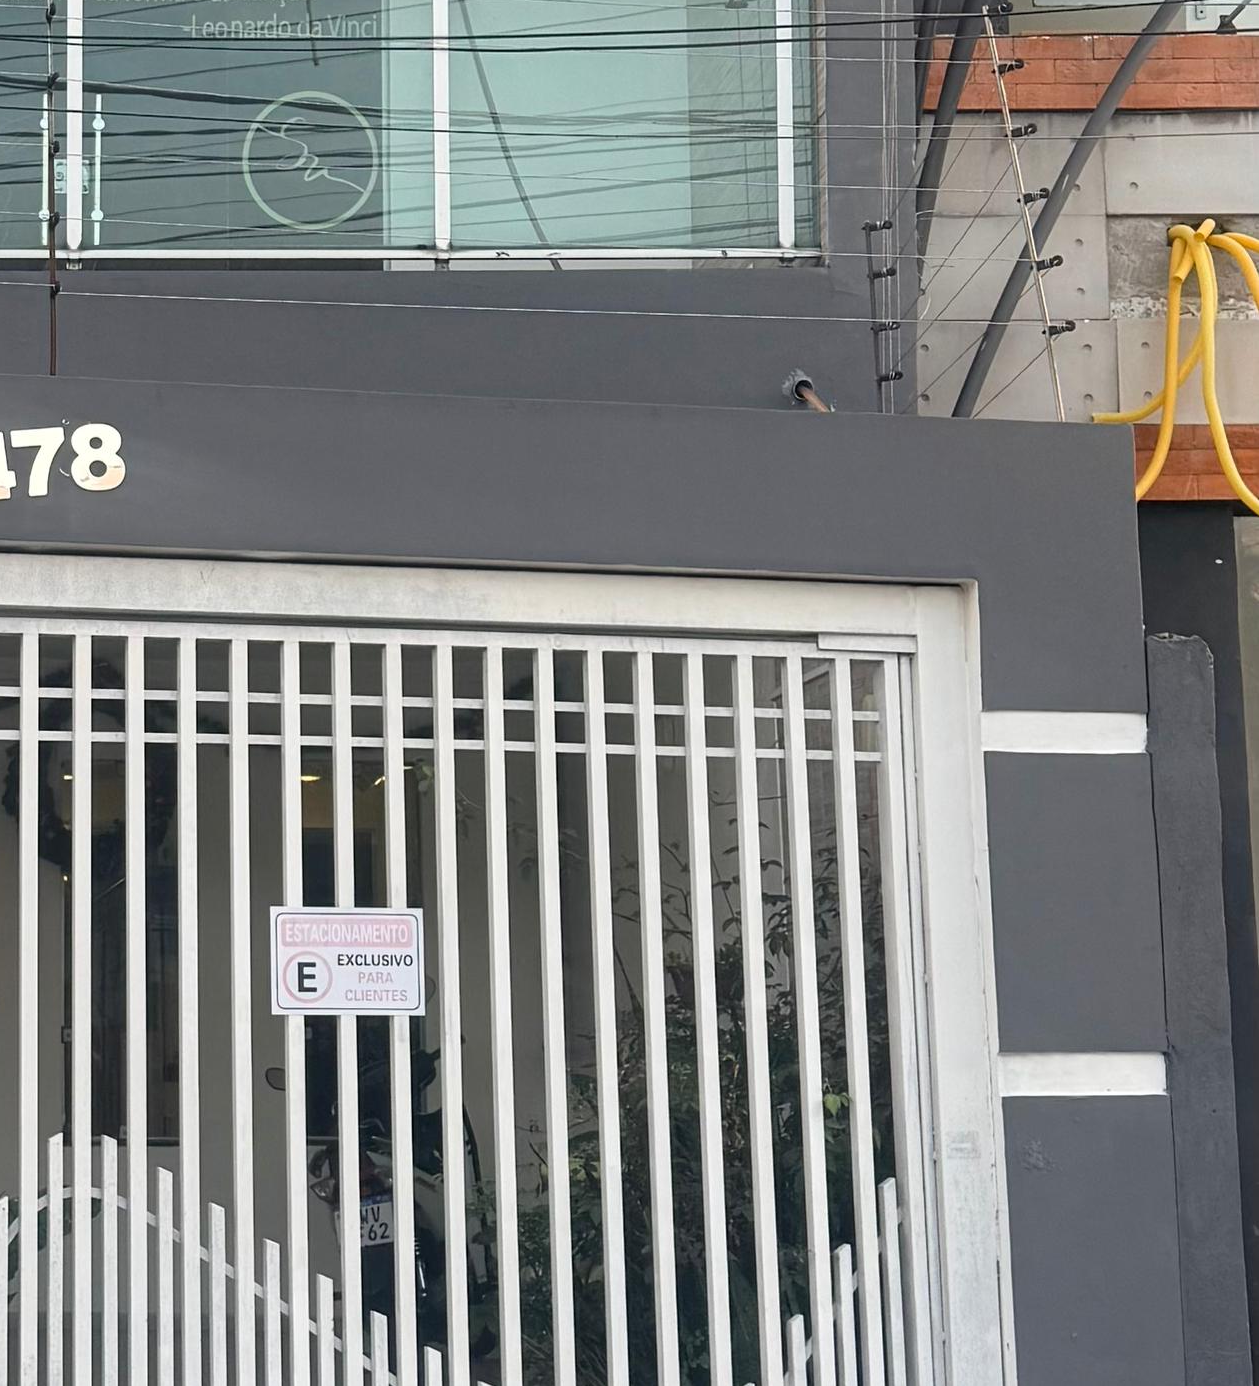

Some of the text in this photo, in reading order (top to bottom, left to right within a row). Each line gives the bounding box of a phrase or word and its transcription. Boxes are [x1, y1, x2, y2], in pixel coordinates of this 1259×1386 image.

[297, 13, 323, 38] da
[285, 922, 409, 944] ESTACIONAMENTO
[296, 954, 413, 993] E EXCLUSIVO
[357, 971, 394, 984] PARA
[345, 988, 408, 1002] CLIENTES
